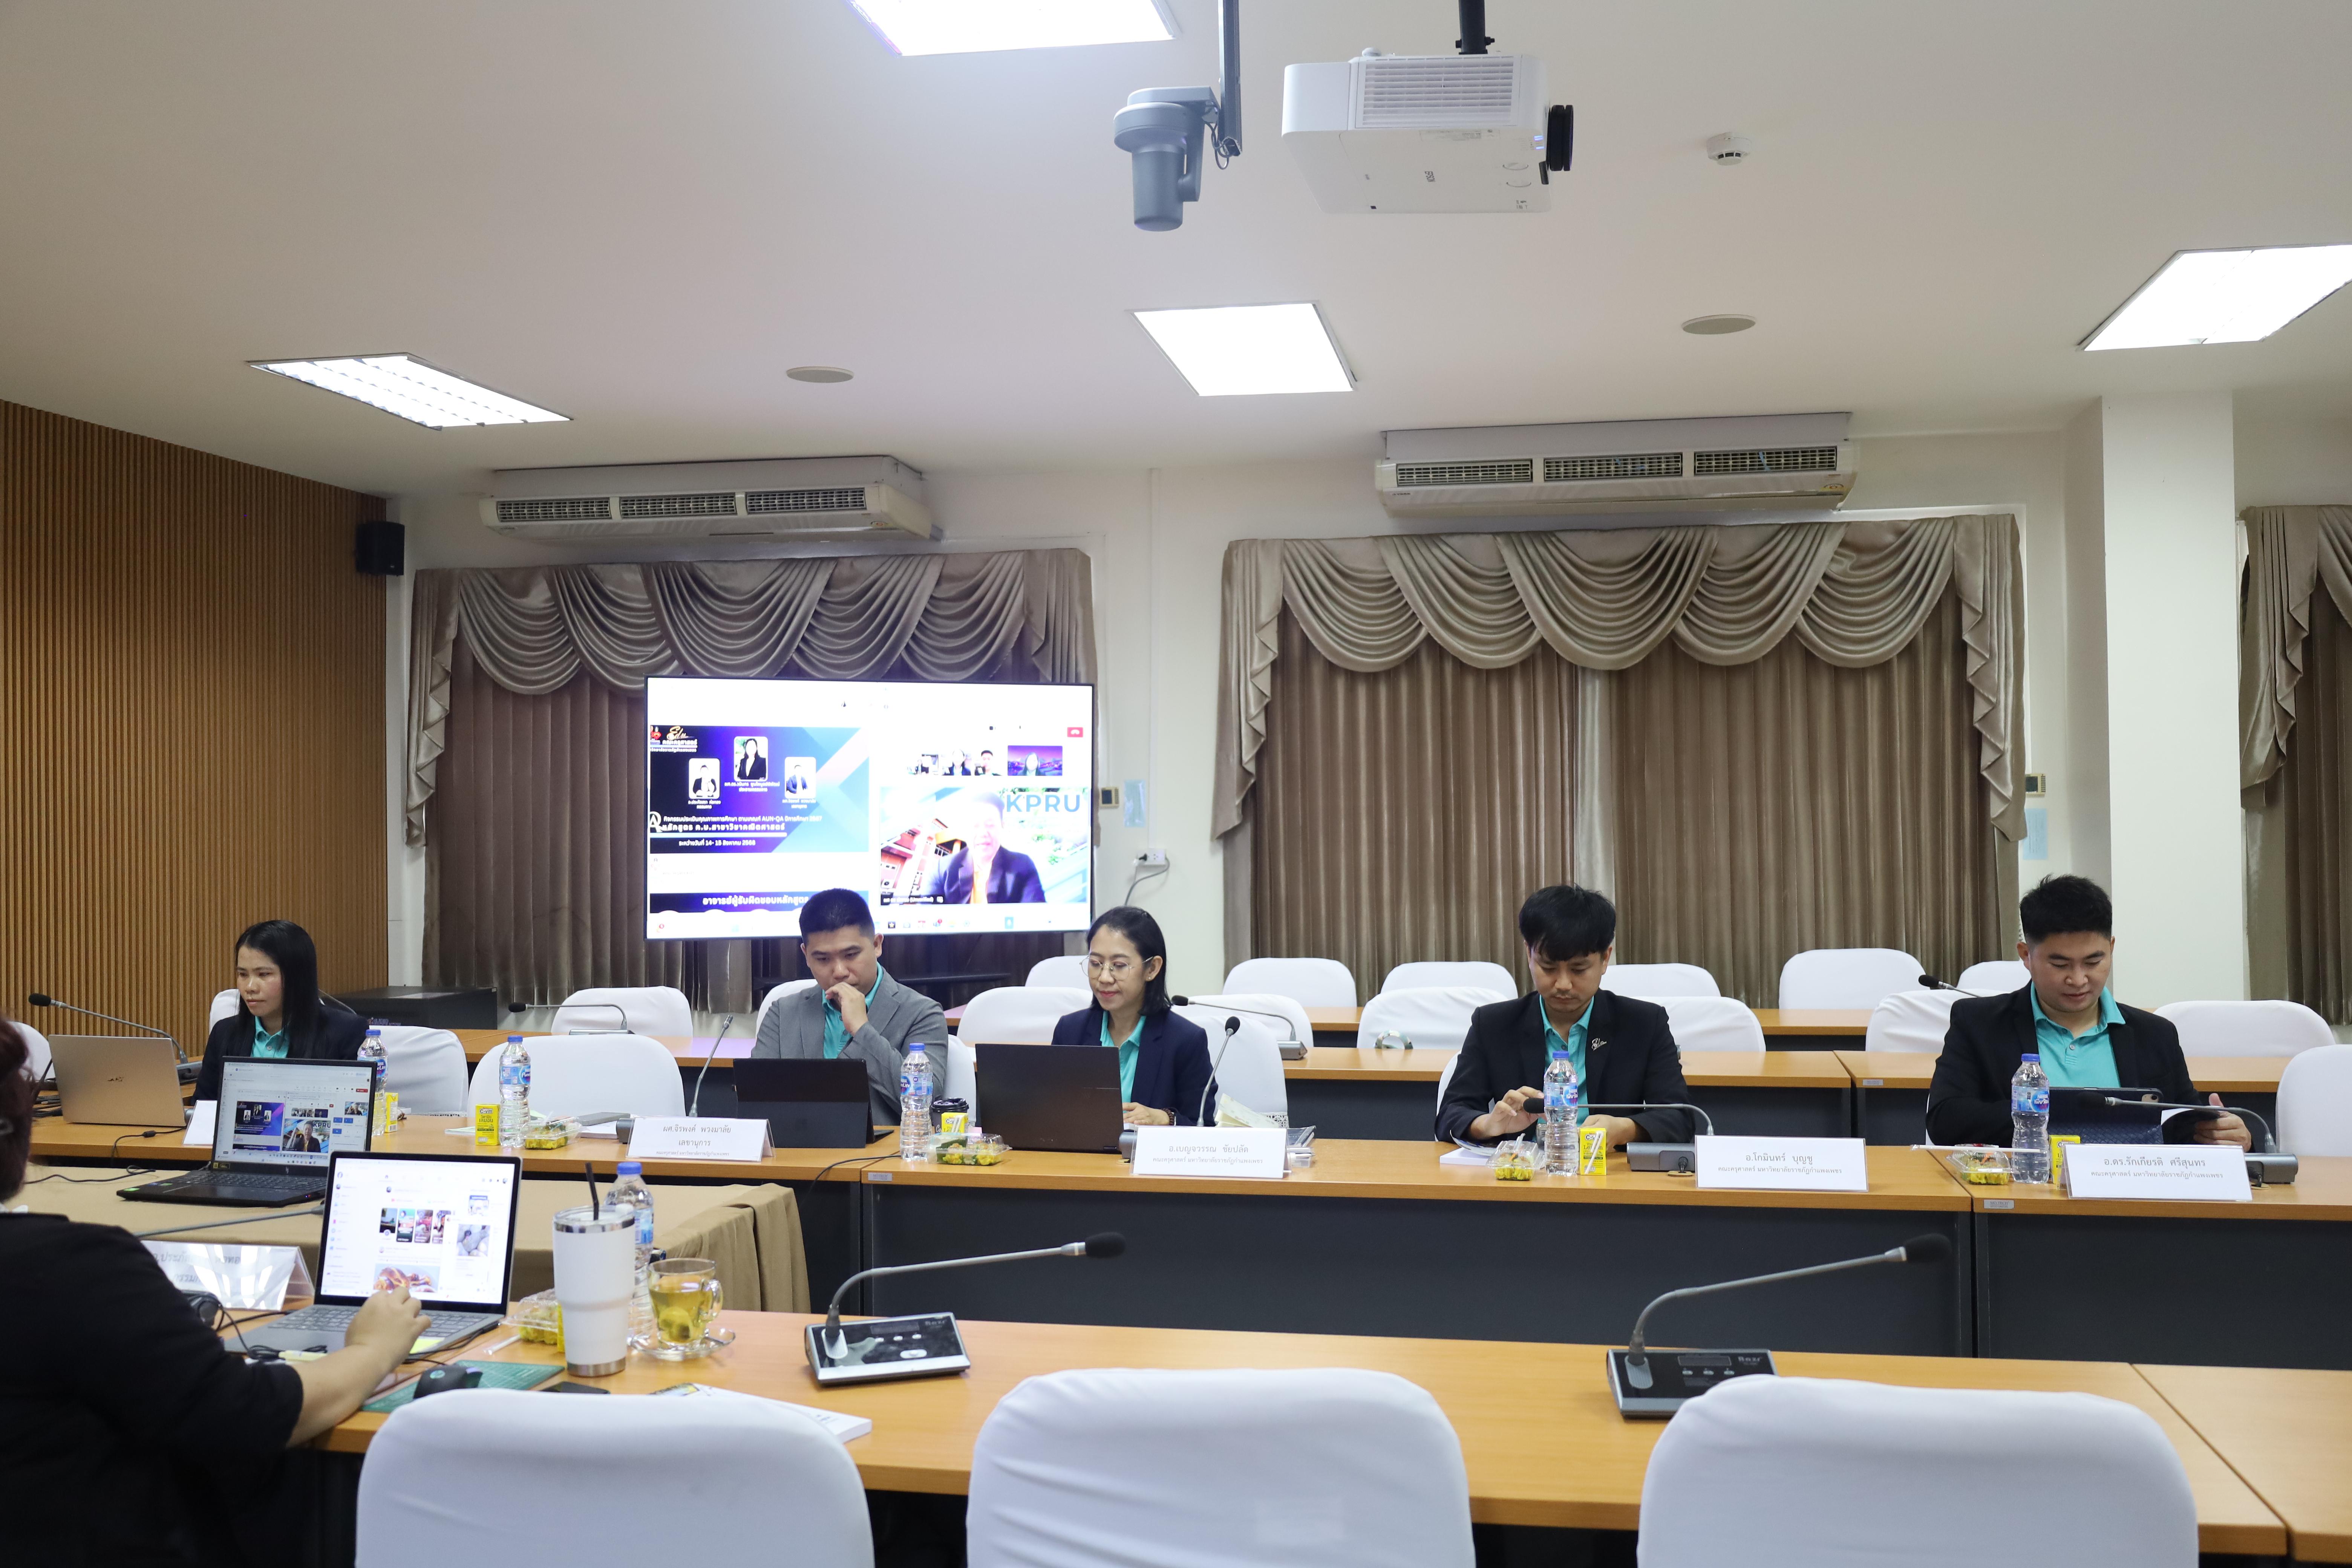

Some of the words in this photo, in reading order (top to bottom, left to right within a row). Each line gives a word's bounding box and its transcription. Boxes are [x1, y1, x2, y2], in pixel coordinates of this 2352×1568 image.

[1425, 171, 1435, 182] EPSON
[1007, 795, 1080, 812] KPRU
[701, 1125, 731, 1133] พวงมาลัย
[678, 1139, 711, 1148] เลขานุการ
[1169, 1145, 1217, 1154] อ.เบญจวรรณ
[1746, 1152, 1785, 1162] อ.โกมินทร์
[1792, 1155, 1813, 1165] บุญชู
[2104, 1156, 2164, 1167] อ.ดร.รักเกียรติ
[2170, 1157, 2206, 1169] ศรีสุนทร
[1757, 1166, 1842, 1175] มหาวิทยาลัยราชภัฏกำแพงเพชร
[2091, 1170, 2131, 1179] คณะครุศาสตร์
[2133, 1171, 2223, 1179] มหาวิทยาลัยราชภัฏกำแพงเพชร
